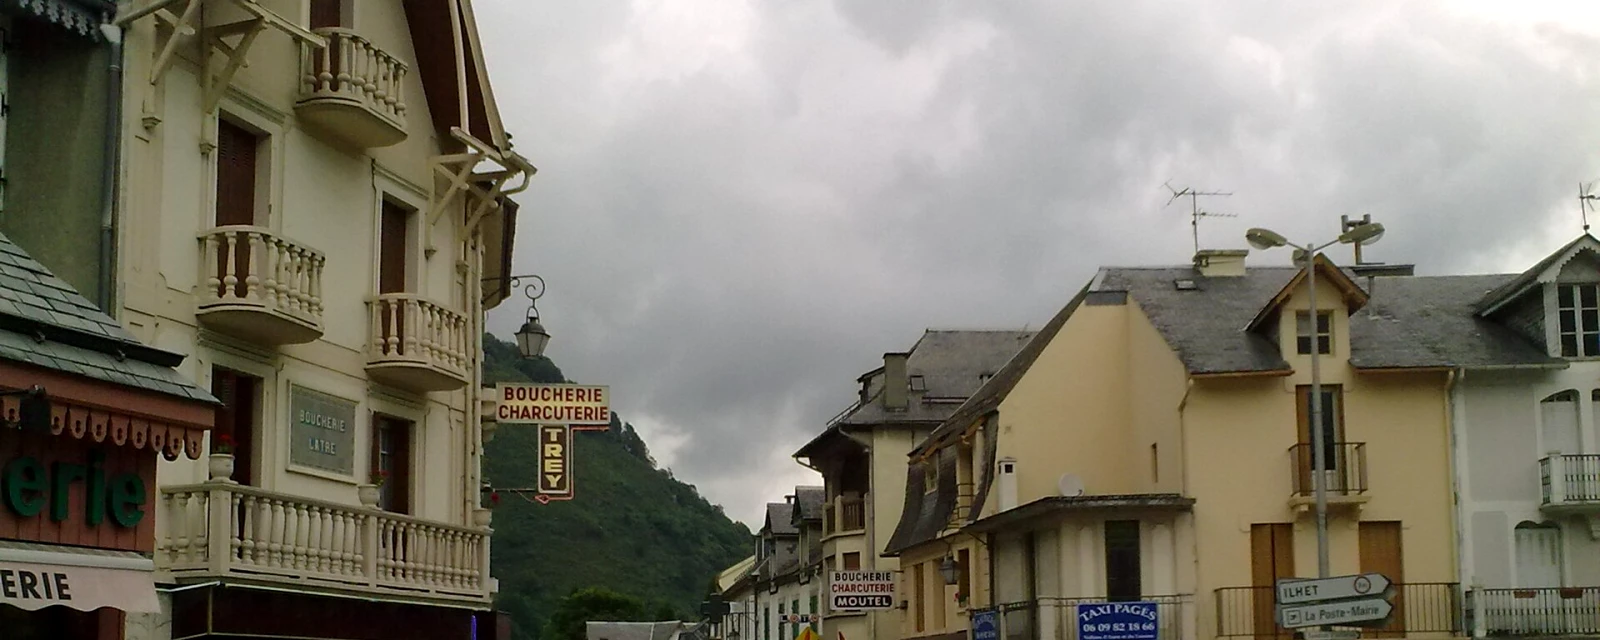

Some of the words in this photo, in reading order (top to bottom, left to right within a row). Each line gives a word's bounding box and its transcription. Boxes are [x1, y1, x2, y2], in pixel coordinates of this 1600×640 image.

[504, 387, 602, 402] BOUCHERIE
[499, 405, 608, 420] CHARCUTERIE
[300, 409, 346, 432] BOUCHERIE
[544, 428, 563, 488] TREY
[3, 449, 147, 528] erie
[835, 572, 891, 581] BOUCHERIE
[0, 570, 72, 600] ERIE
[832, 583, 895, 593] CHARCUTERIE
[1283, 585, 1319, 598] ILHET
[837, 597, 889, 606] MOUTEL
[1080, 605, 1111, 621] TAXI
[1305, 611, 1316, 621] La
[1319, 605, 1380, 620] Poste-Mairie
[1083, 623, 1096, 632] 06
[1098, 623, 1111, 632] 09
[1112, 623, 1126, 632] 82
[1128, 623, 1140, 631] 18
